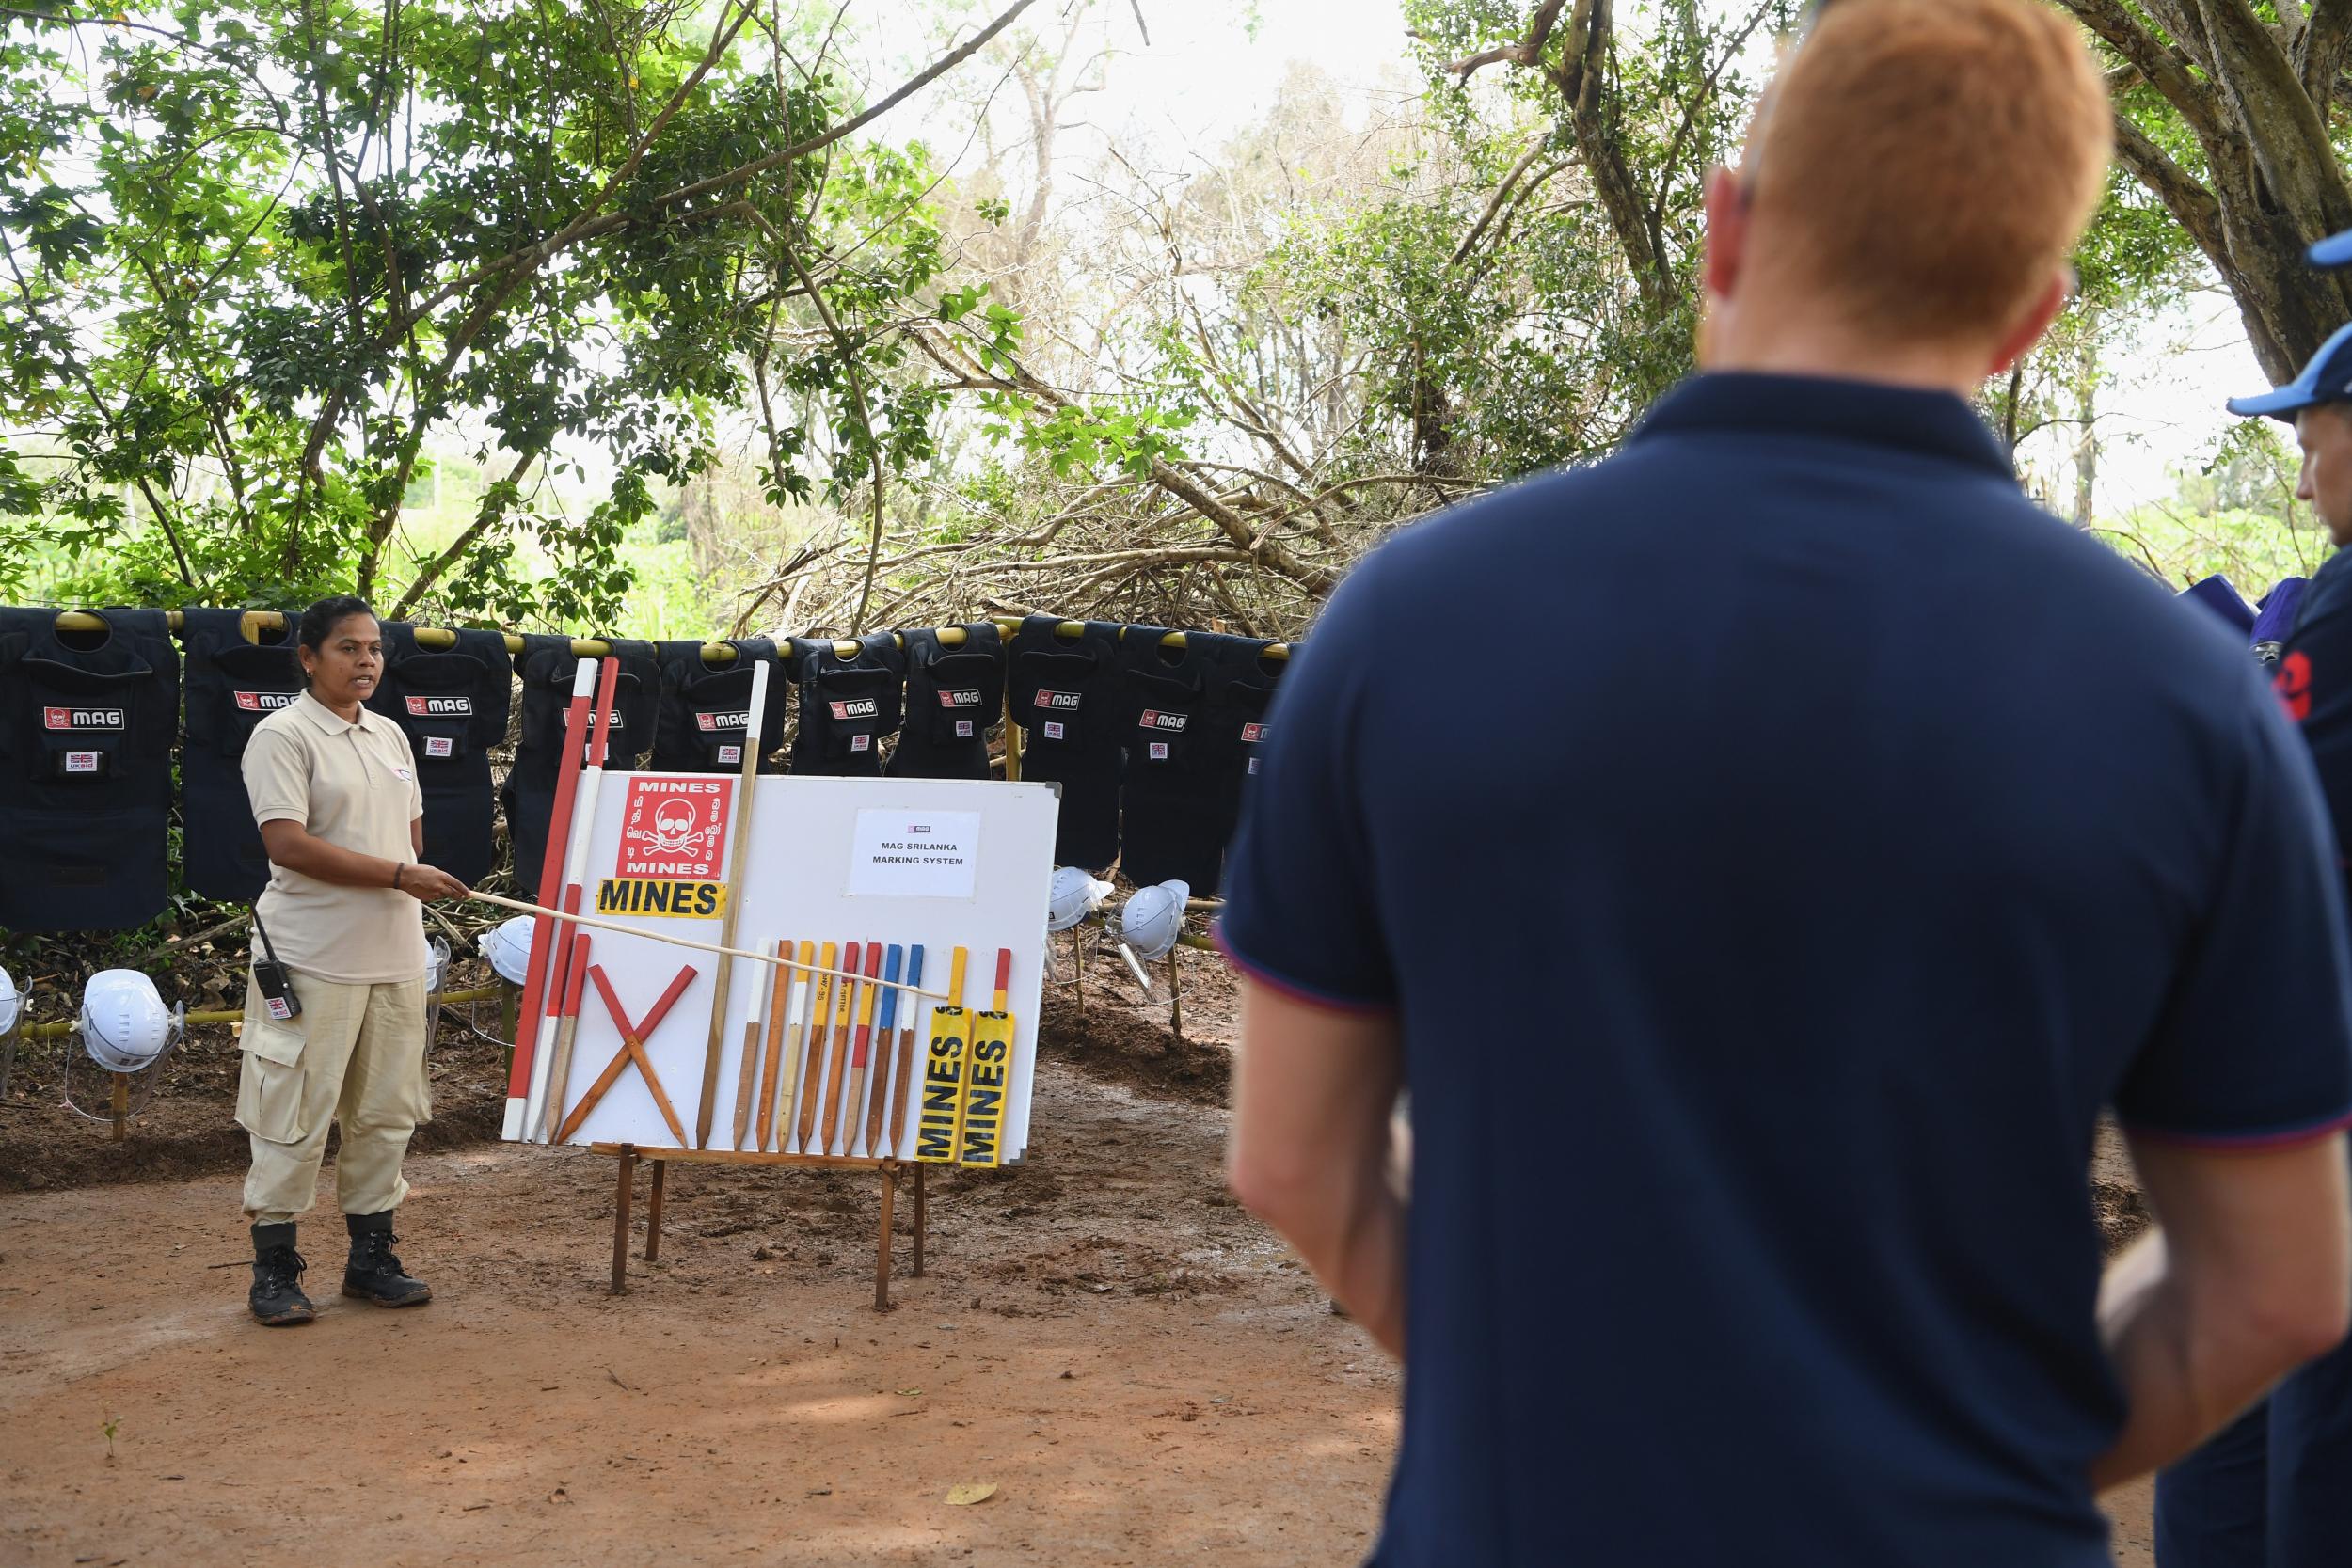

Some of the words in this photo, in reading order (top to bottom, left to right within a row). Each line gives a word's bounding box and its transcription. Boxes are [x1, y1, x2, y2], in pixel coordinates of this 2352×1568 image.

[953, 691, 979, 704] MAG
[1052, 694, 1079, 706] MAG
[428, 699, 469, 712] MAG
[846, 701, 875, 715] MAG
[72, 711, 120, 725] MAG
[1156, 715, 1185, 728] MAG
[638, 782, 721, 794] MINES
[881, 842, 904, 850] MAG
[906, 843, 958, 851] SRILANKA
[872, 856, 920, 864] MARKING
[923, 857, 963, 865] SYSTEM
[626, 863, 709, 875] MINES
[599, 879, 718, 915] MINES
[917, 1036, 963, 1158] MINES
[962, 1040, 1007, 1163] MINES
